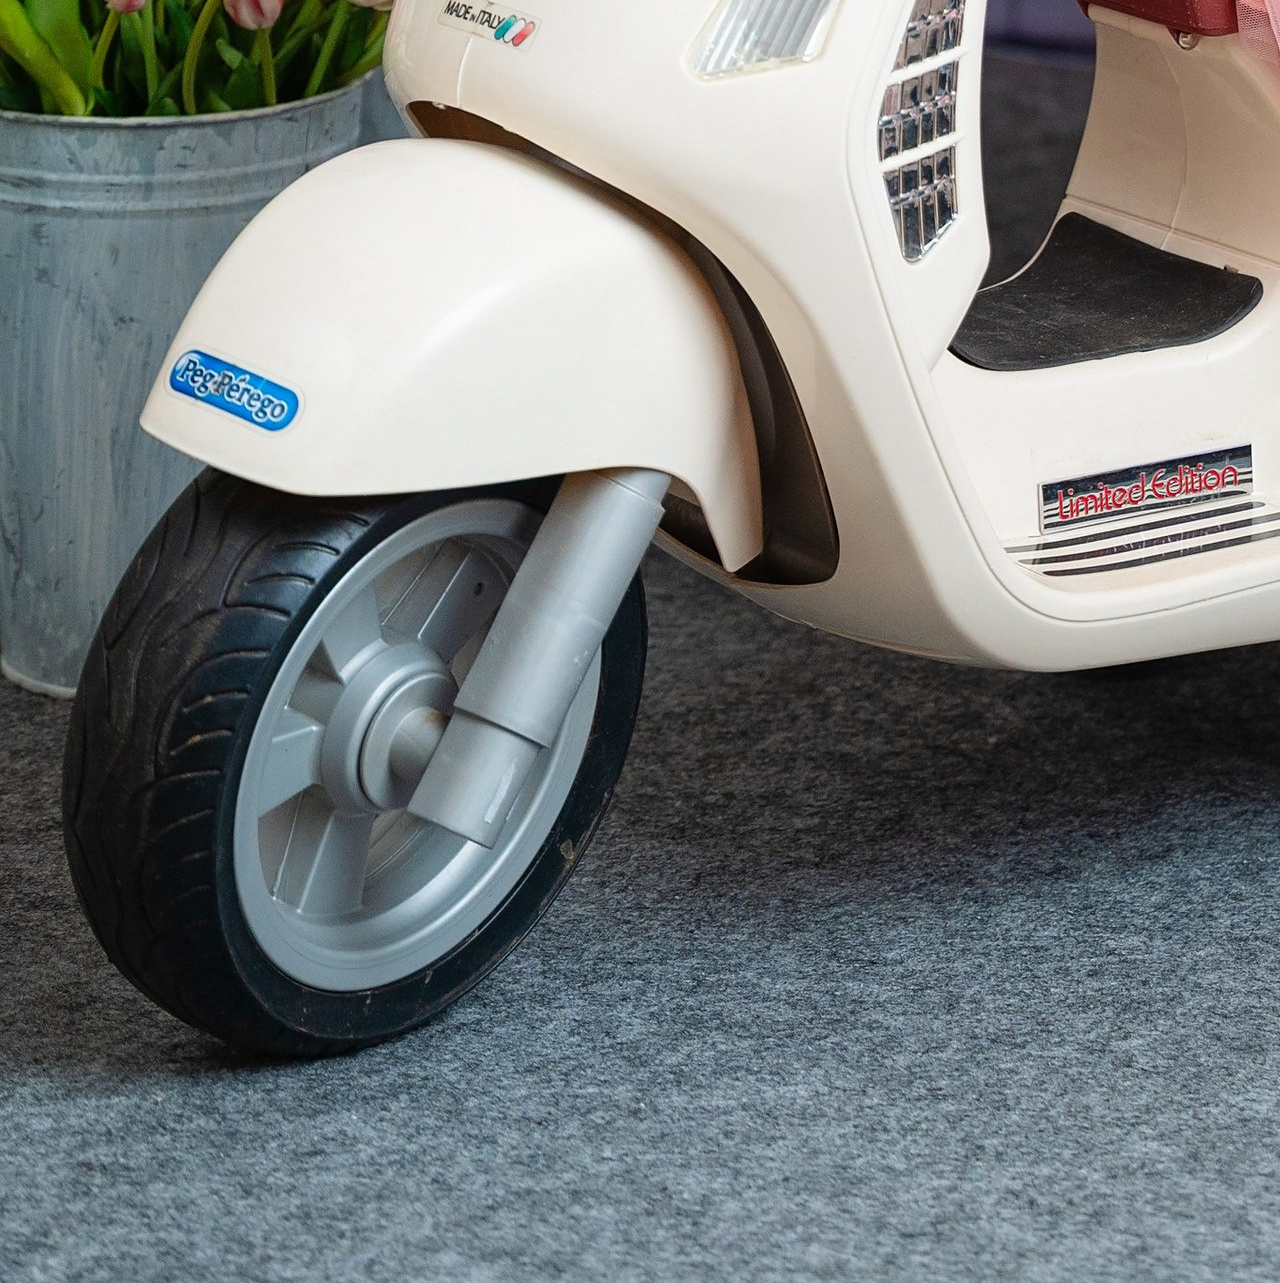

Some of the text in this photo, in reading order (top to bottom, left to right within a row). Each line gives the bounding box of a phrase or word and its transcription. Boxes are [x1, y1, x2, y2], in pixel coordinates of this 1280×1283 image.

[443, 0, 473, 21] MADE
[475, 9, 506, 30] ITALY
[1057, 463, 1238, 520] Limited Edition
